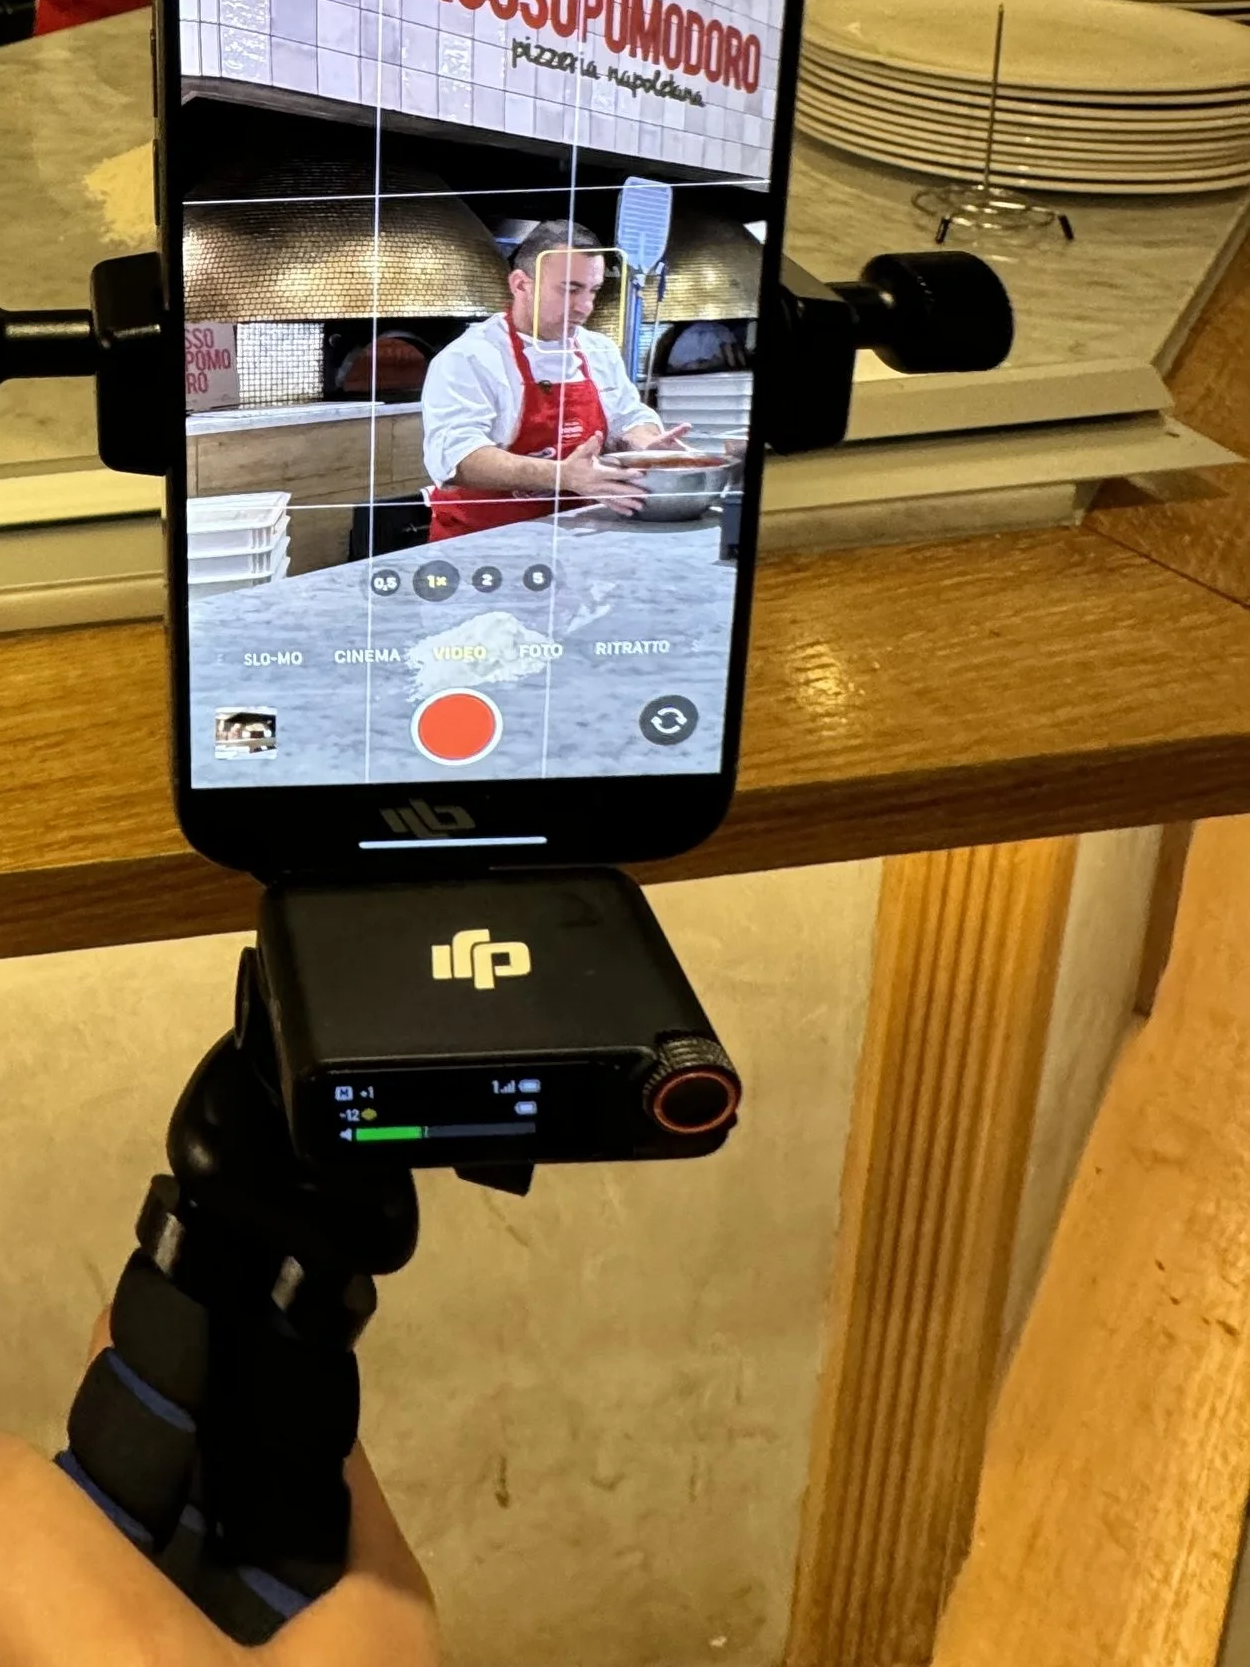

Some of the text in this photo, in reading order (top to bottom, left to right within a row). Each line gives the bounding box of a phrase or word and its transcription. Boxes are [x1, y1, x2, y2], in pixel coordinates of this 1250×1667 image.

[512, 35, 707, 108] pizzeria napoletana
[185, 348, 231, 372] POMO
[481, 573, 494, 587] 2
[532, 571, 545, 585] 5
[243, 650, 304, 667] SLO-MO
[334, 647, 402, 664] CINEMA
[432, 644, 488, 664] VIDEO
[518, 642, 564, 659] FOTO
[594, 639, 671, 656] RITRATTO
